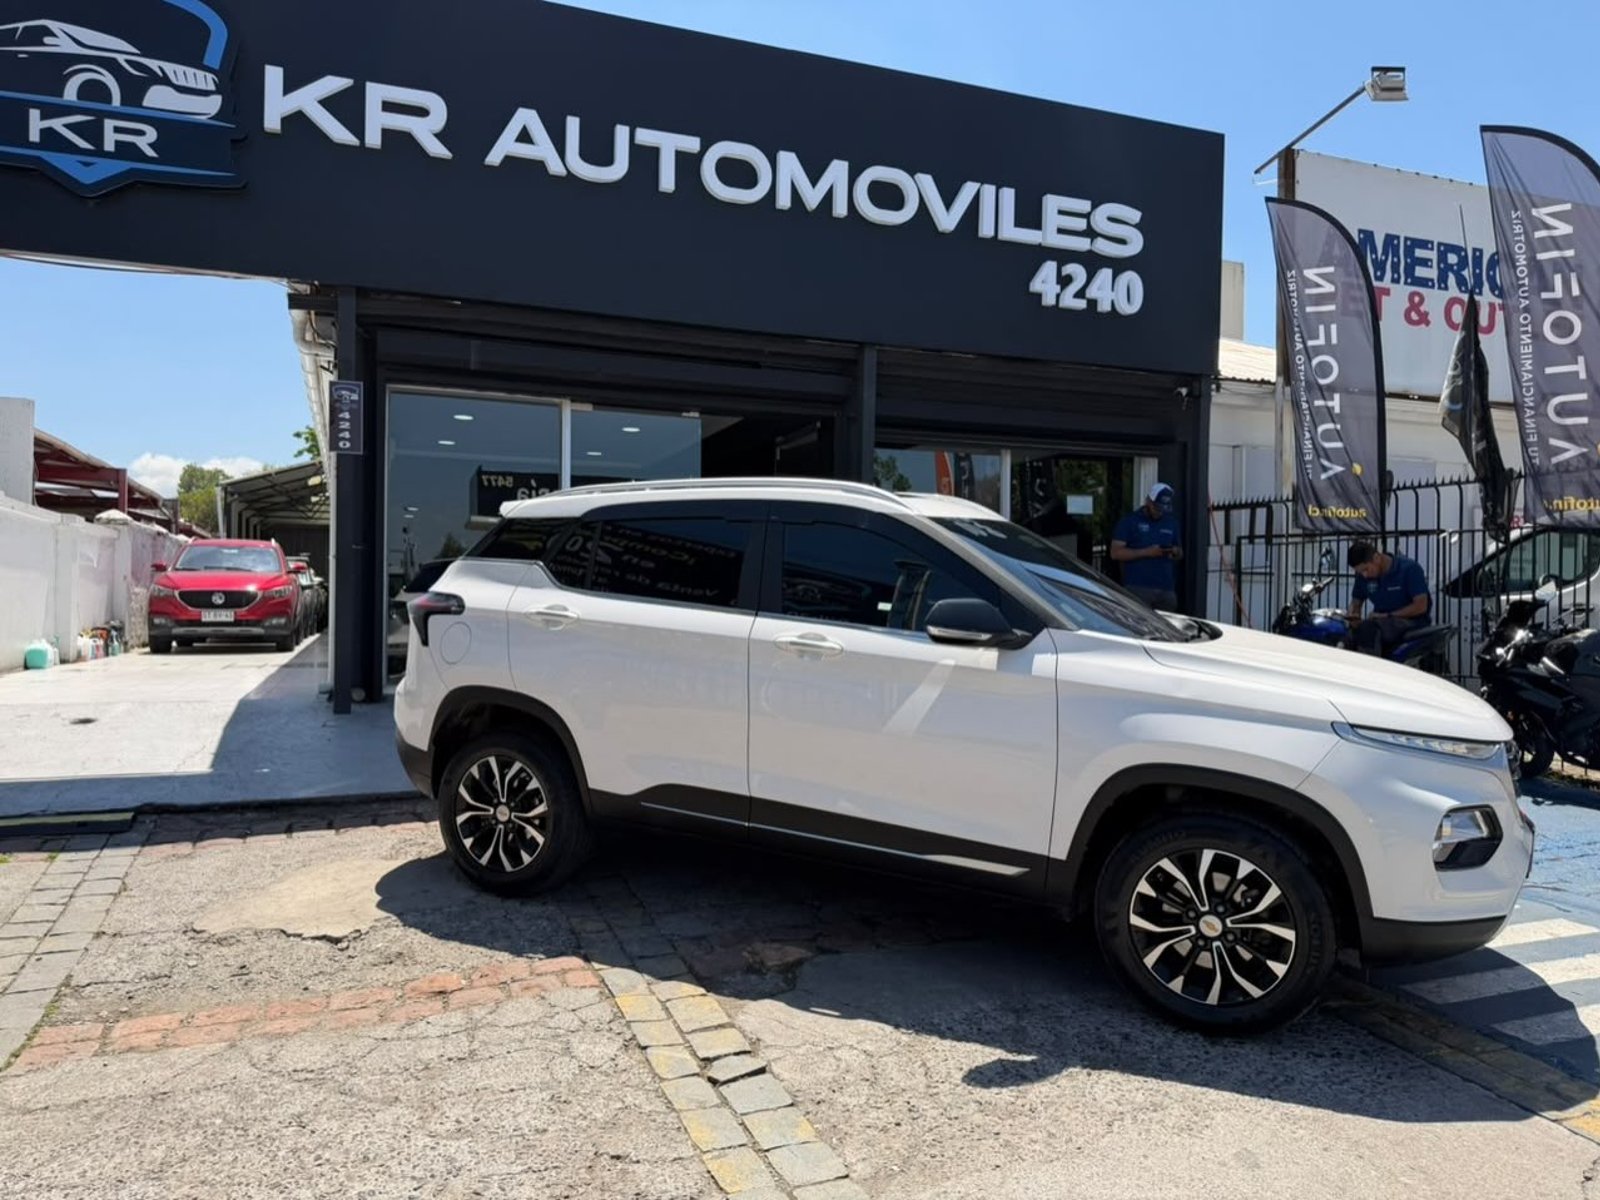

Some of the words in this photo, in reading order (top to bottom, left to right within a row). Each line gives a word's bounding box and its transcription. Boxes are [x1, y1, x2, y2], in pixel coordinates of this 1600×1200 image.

[28, 108, 160, 159] KR
[264, 64, 454, 160] KR
[484, 106, 1144, 259] AUTOMOVILES
[1029, 259, 1144, 316] 4240
[1404, 290, 1431, 327] &
[338, 411, 351, 449] 4240
